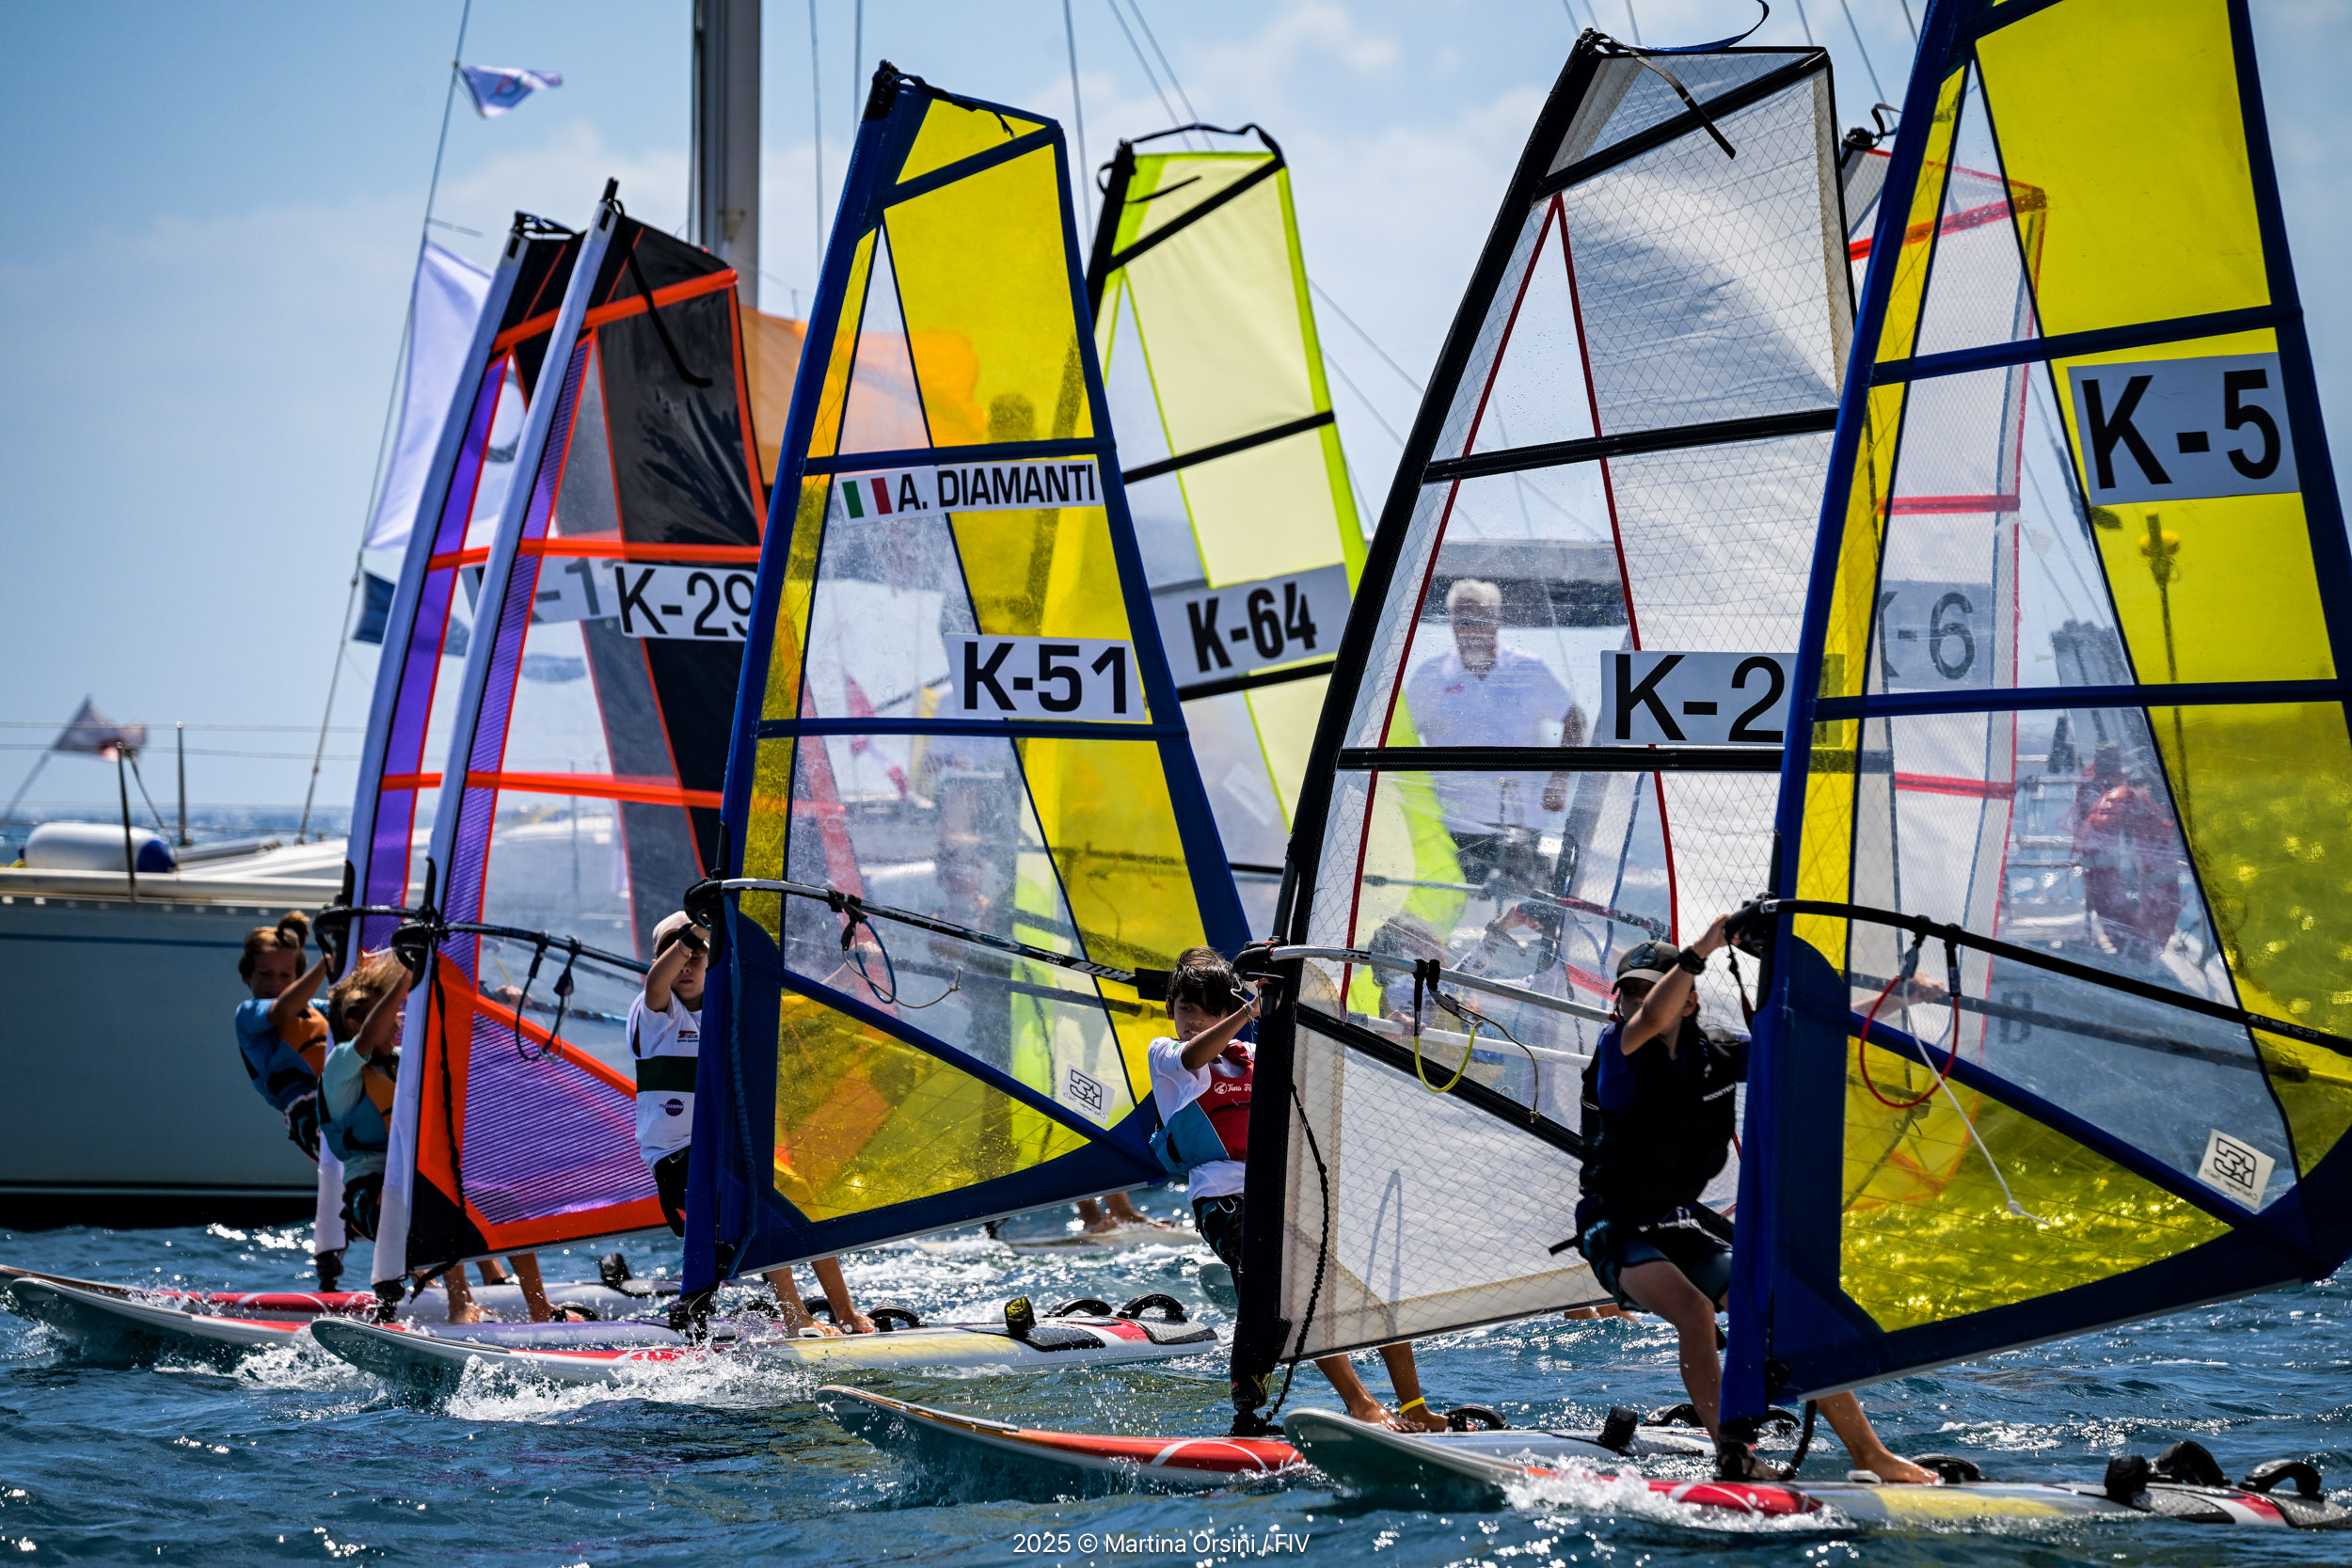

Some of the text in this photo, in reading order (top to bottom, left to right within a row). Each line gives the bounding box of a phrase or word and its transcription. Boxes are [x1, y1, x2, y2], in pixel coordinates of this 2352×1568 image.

[2081, 368, 2280, 489] K-5
[898, 464, 1096, 512] A. DIAMANTI
[614, 566, 755, 637] K-29
[1186, 581, 1317, 673] K-64
[964, 641, 1127, 714] K-51
[1703, 1083, 1735, 1101] ROOSTER
